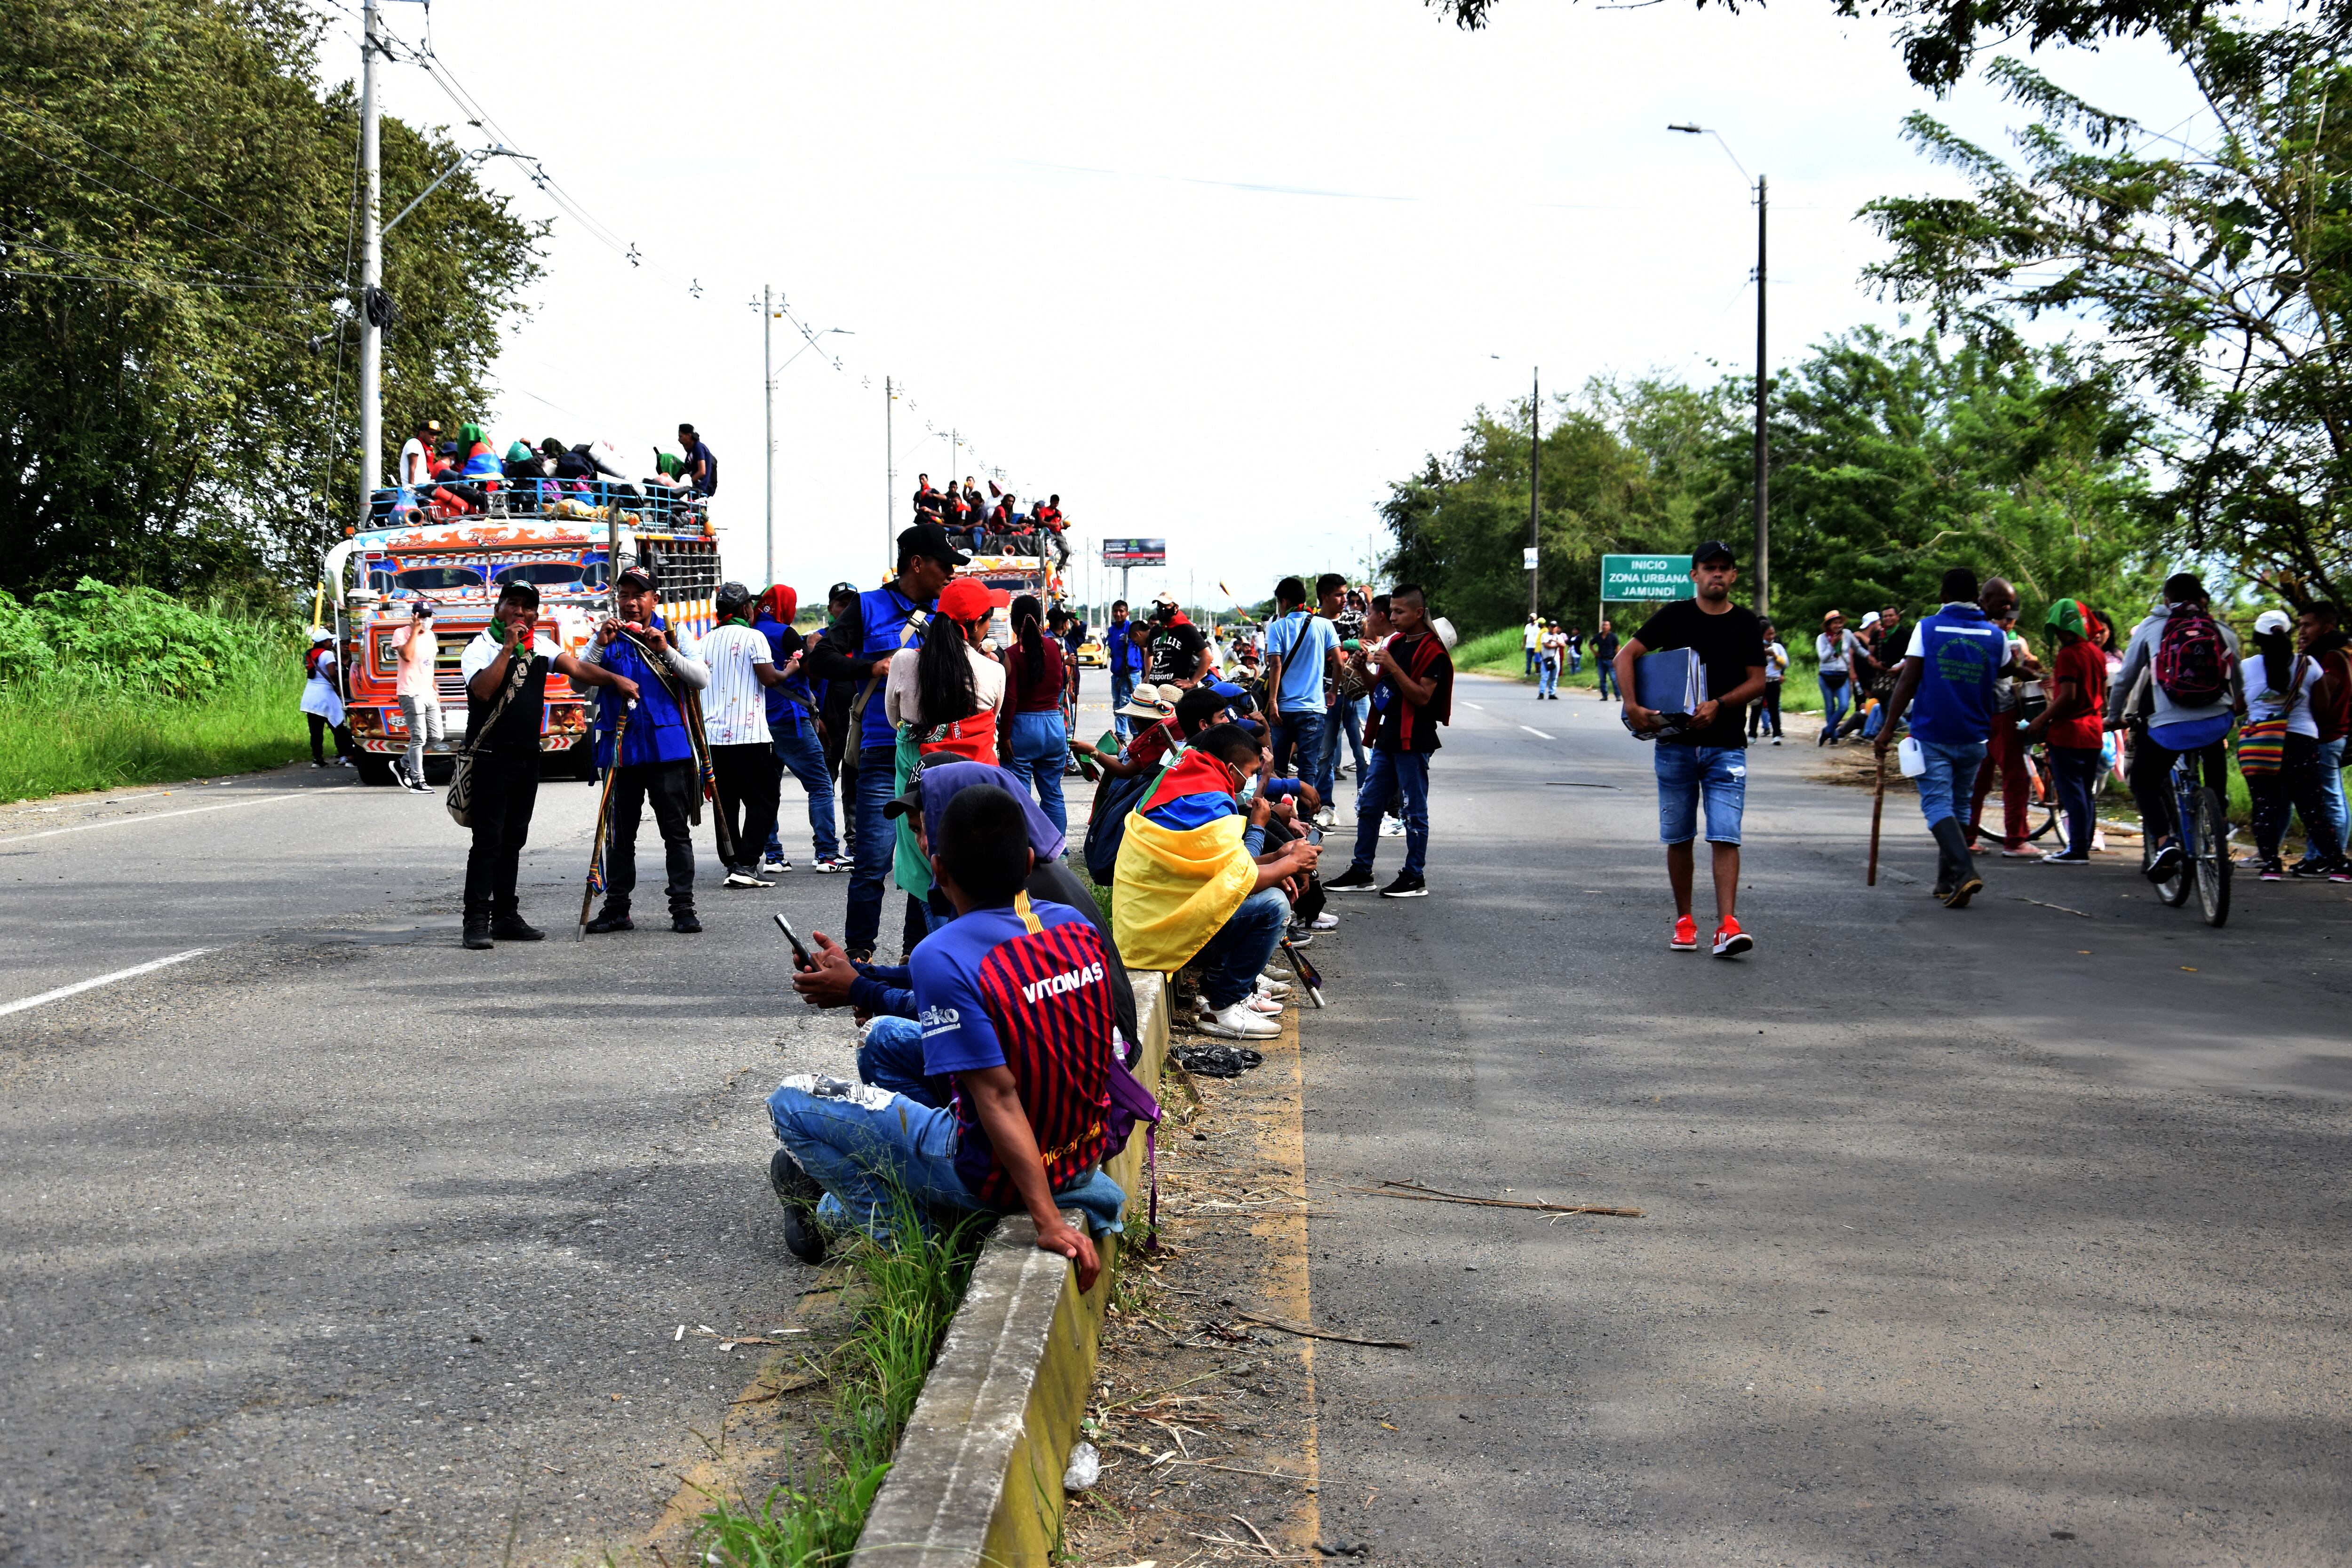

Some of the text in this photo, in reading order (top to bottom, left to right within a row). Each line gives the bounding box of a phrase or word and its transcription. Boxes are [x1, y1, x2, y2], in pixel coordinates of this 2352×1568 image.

[406, 553, 572, 567] EL GLADIADOR
[1631, 560, 1668, 570] INICIO
[1609, 573, 1689, 583] ZONA URBANA
[1622, 585, 1677, 596] JAMUNDÍ
[1154, 651, 1163, 665] 3
[1022, 962, 1104, 1004] VITONAS
[1041, 1133, 1083, 1166] nicef
